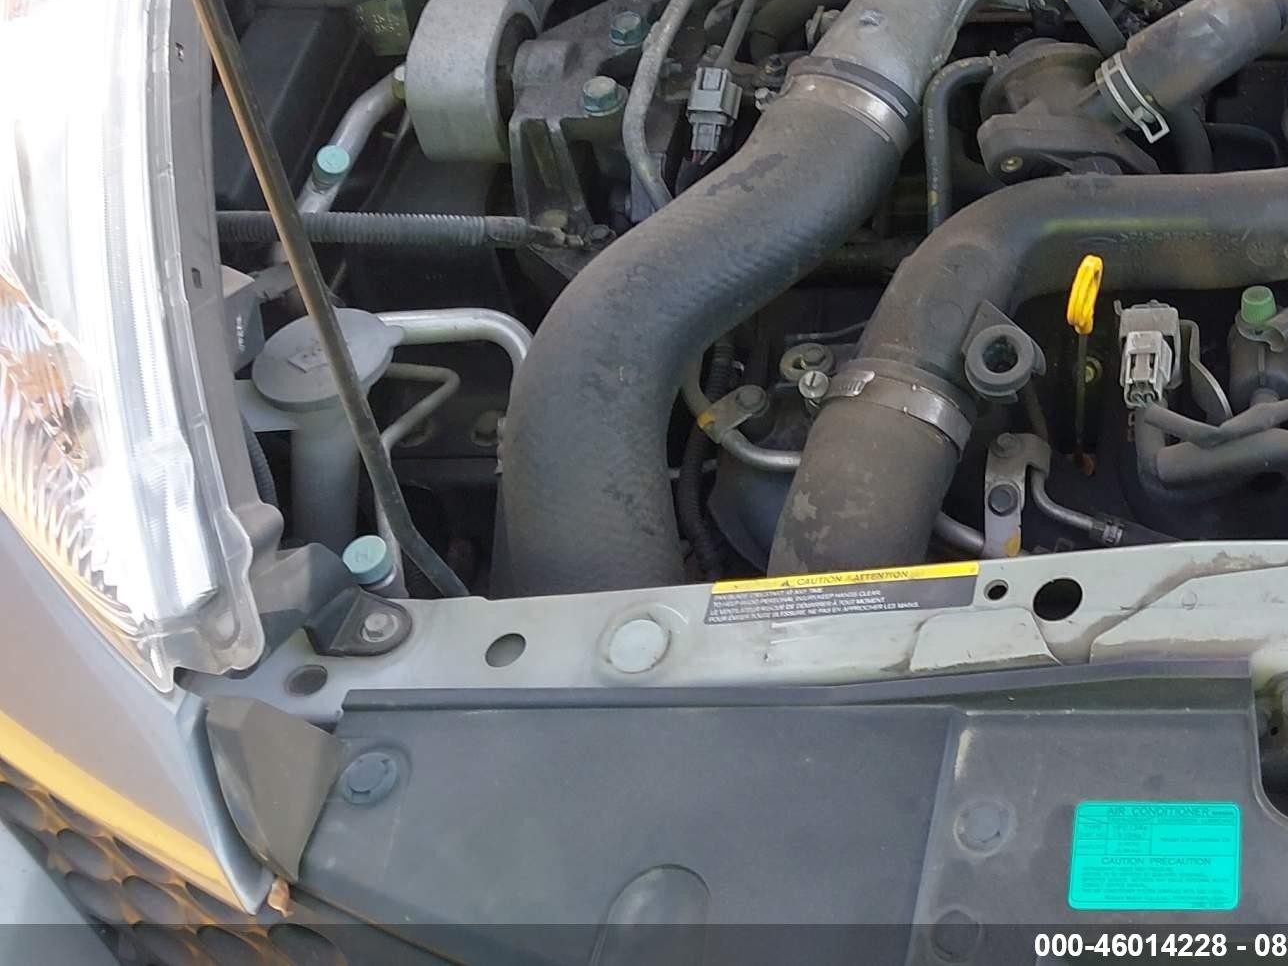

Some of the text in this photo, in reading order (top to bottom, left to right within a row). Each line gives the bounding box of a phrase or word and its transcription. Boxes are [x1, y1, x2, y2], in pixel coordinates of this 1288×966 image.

[796, 571, 908, 586] CAUTION ATTENTION
[1107, 807, 1125, 817] AIR
[1132, 807, 1209, 817] CONDITIONER
[1102, 857, 1211, 866] CAUTION PRECAUTION
